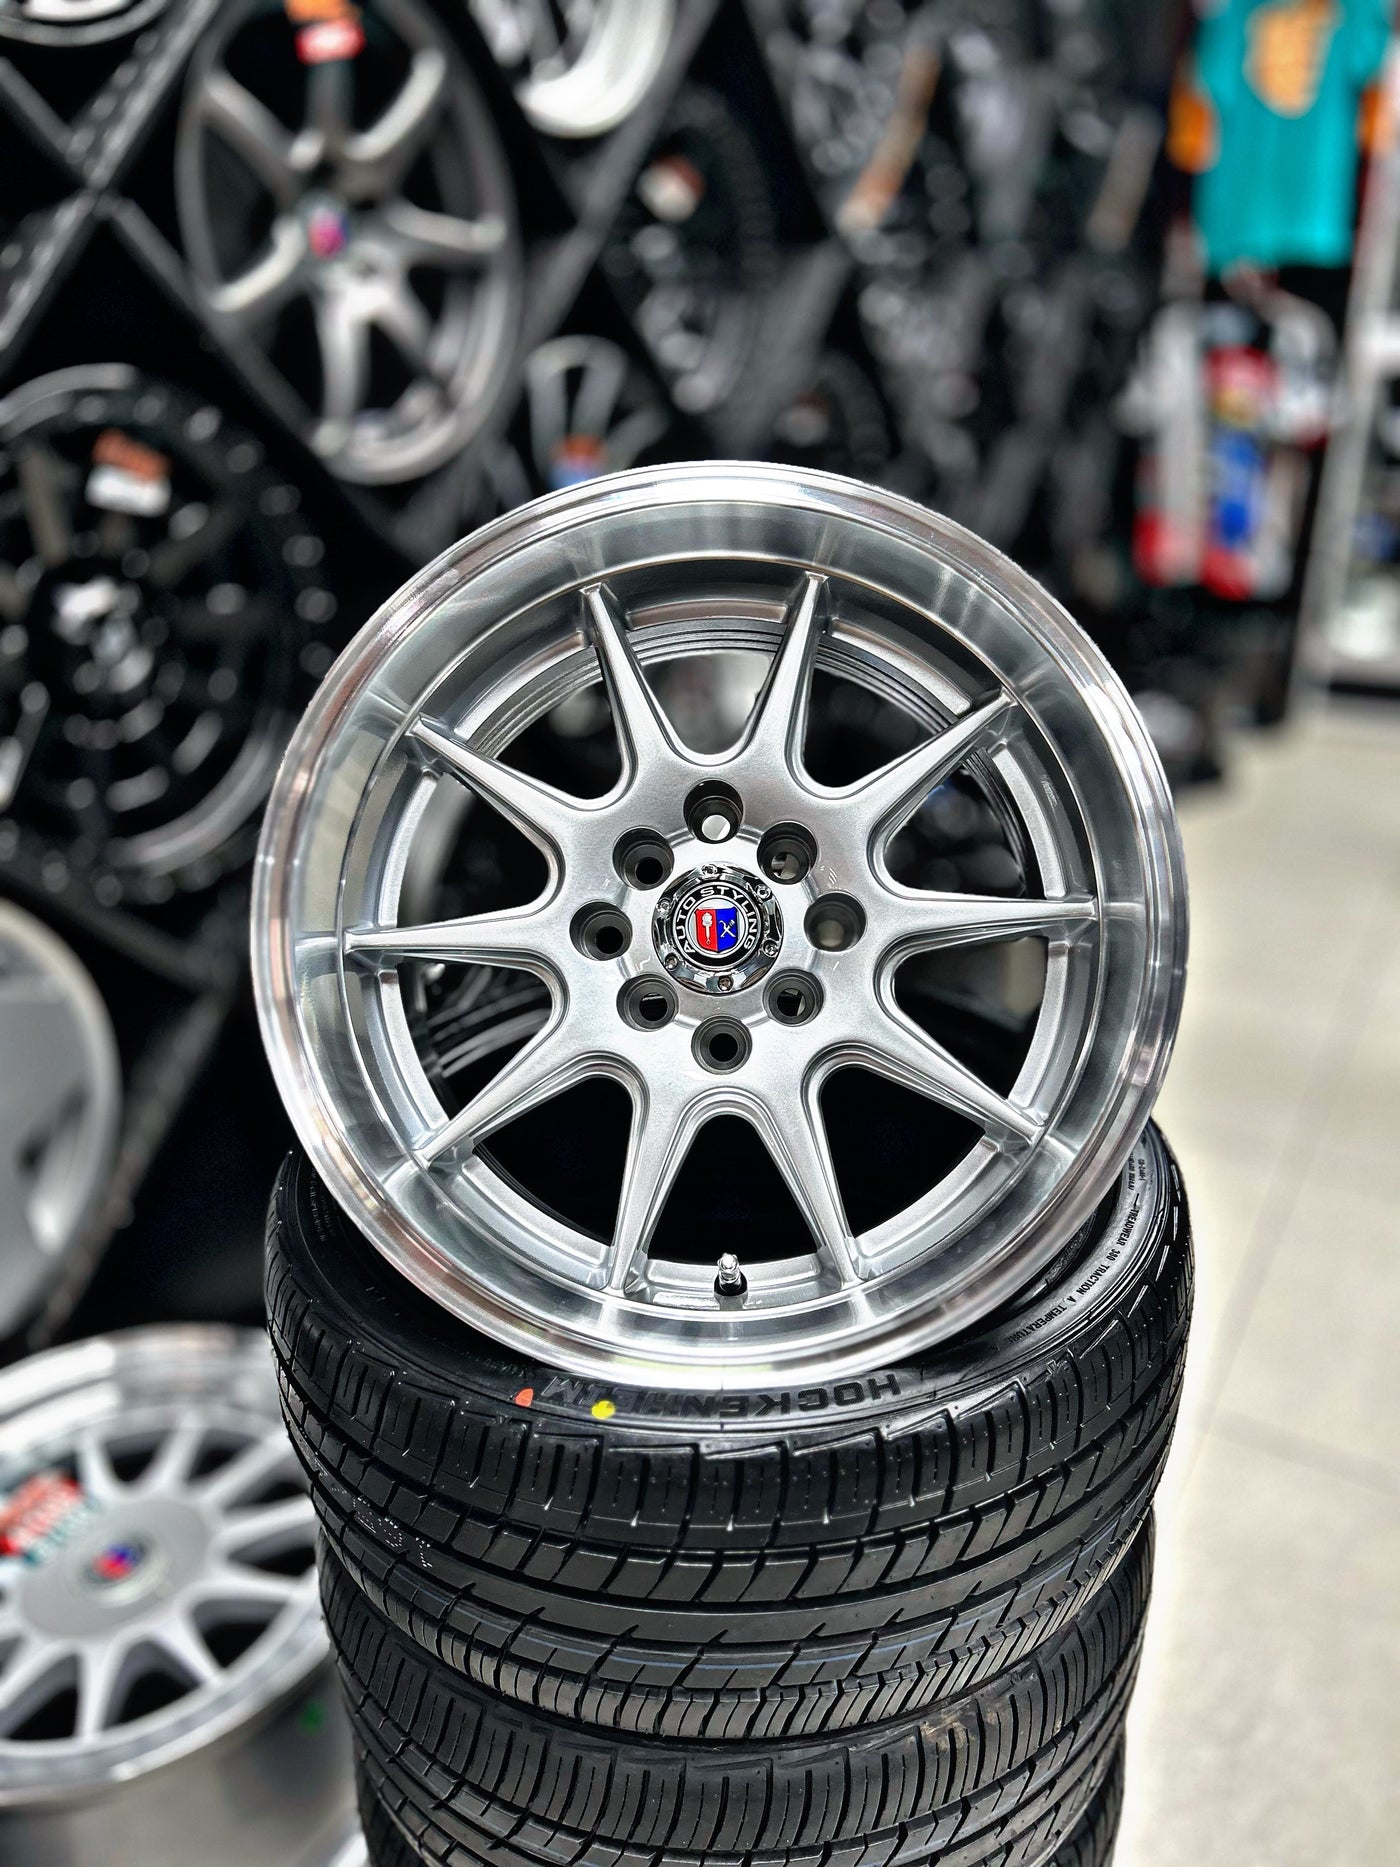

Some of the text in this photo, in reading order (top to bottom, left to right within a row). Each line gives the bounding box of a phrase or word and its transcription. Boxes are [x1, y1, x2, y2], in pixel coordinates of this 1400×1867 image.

[676, 886, 757, 953] AUTO STYLING
[1117, 1209, 1139, 1245] TREADWEAR
[1078, 1264, 1109, 1294] TRACTION
[1009, 1304, 1067, 1343] TEMPERATURE
[541, 1374, 901, 1417] HOCKENHEIM
